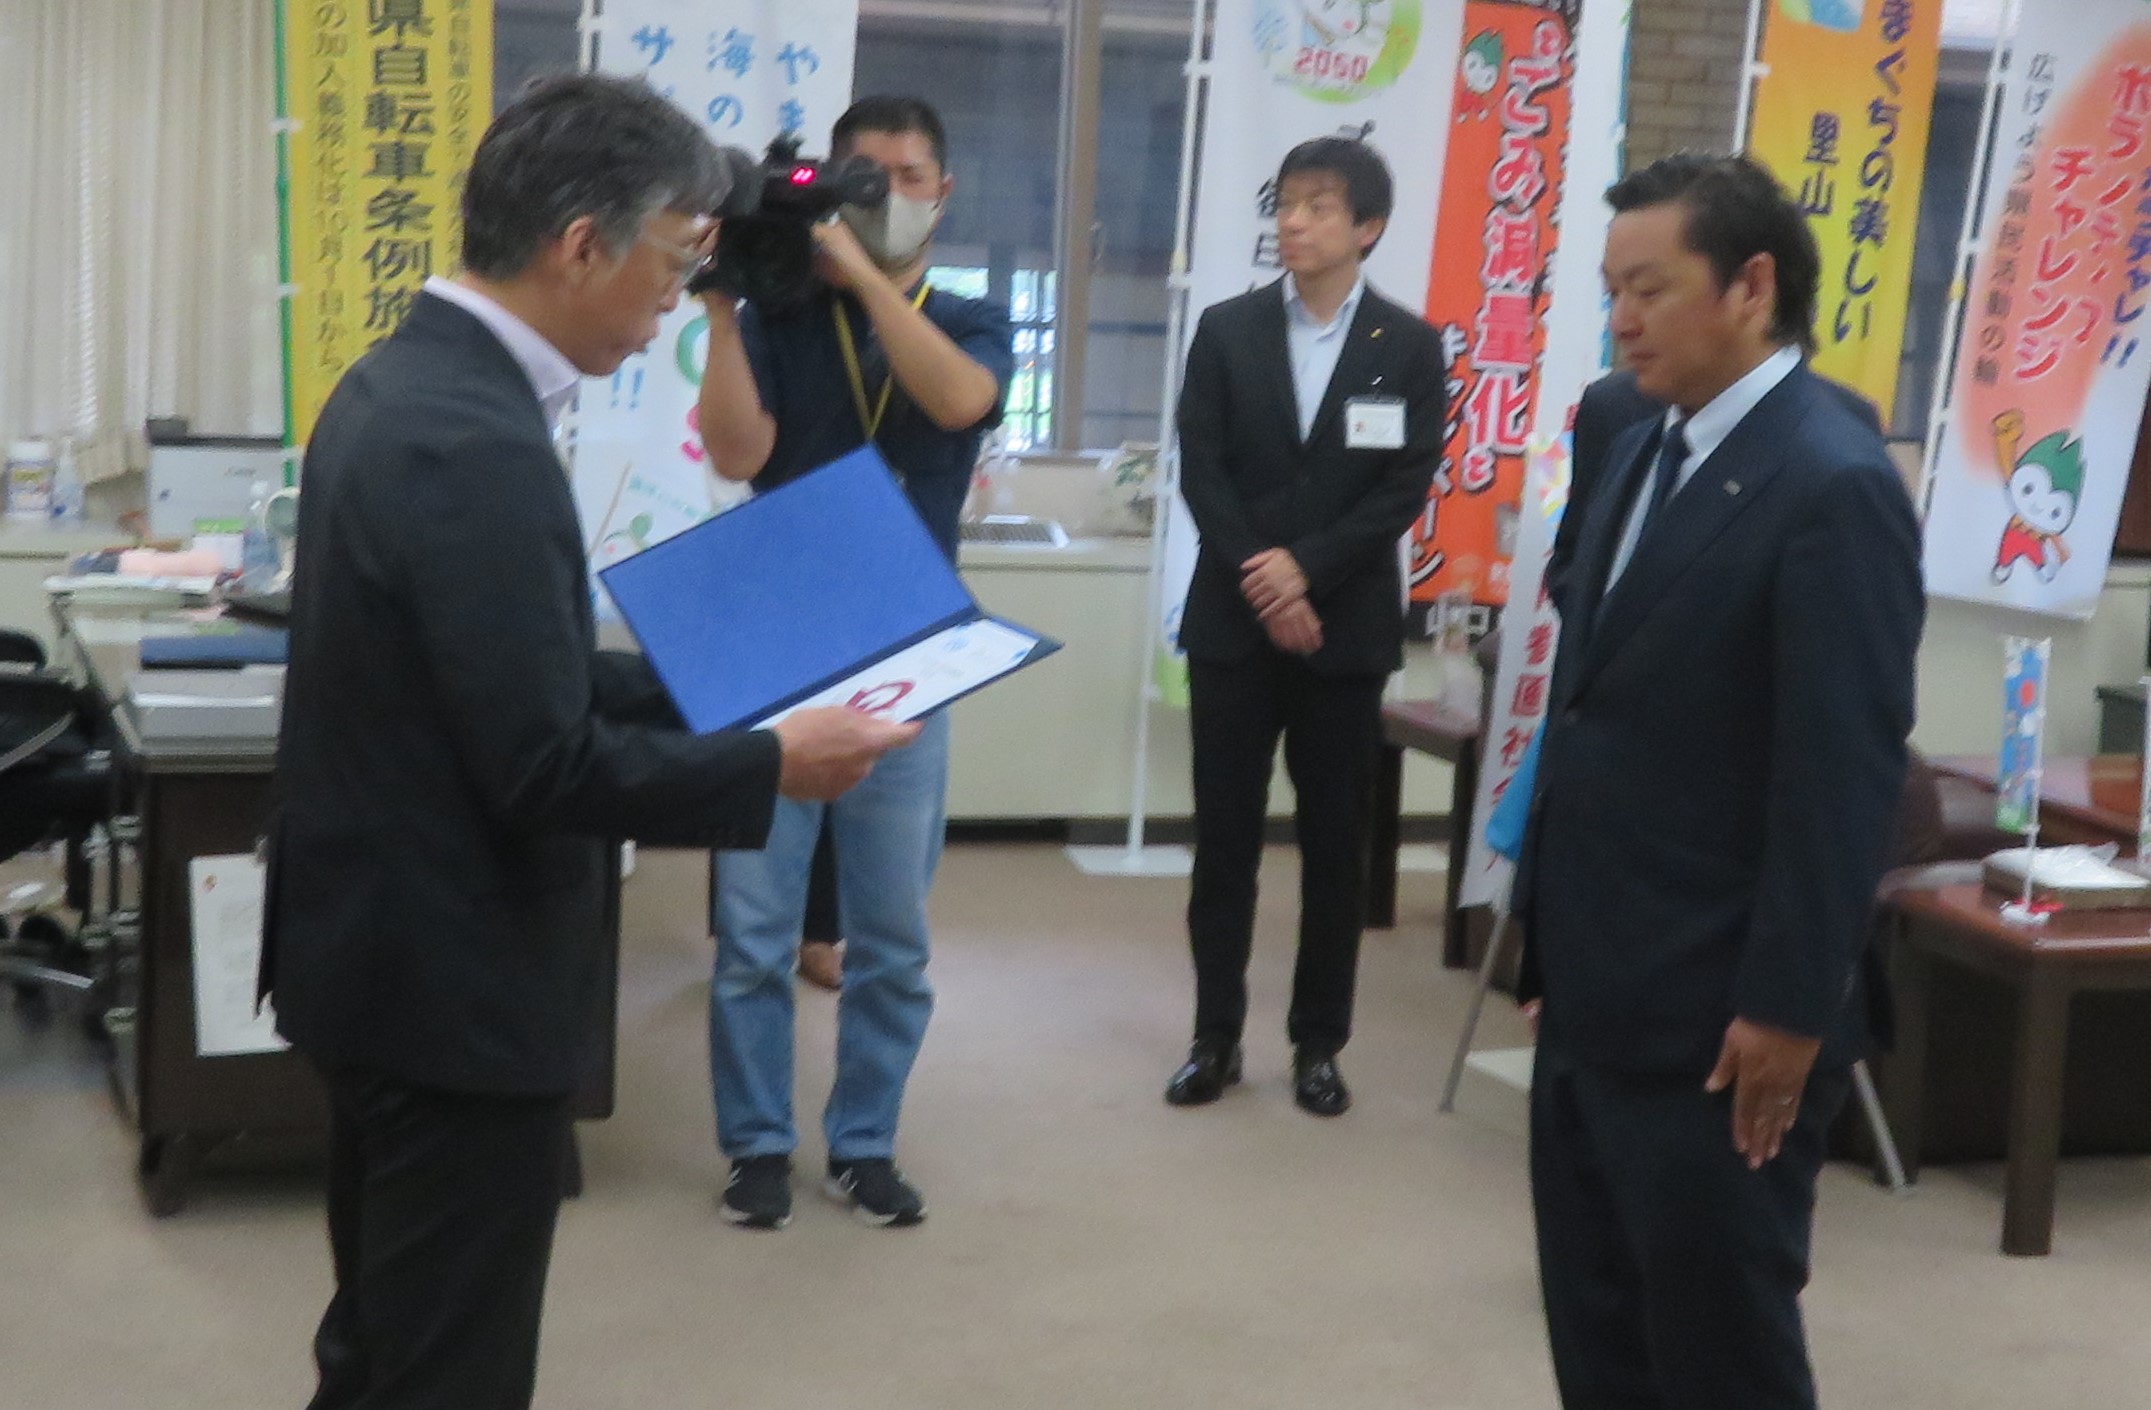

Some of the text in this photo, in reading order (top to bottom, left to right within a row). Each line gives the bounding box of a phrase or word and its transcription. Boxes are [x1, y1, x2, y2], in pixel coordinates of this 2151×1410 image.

[707, 27, 754, 128] 海の
[363, 0, 434, 348] 県自転車条例施
[1803, 111, 1840, 217] 里山
[2015, 148, 2095, 380] チャレンジ
